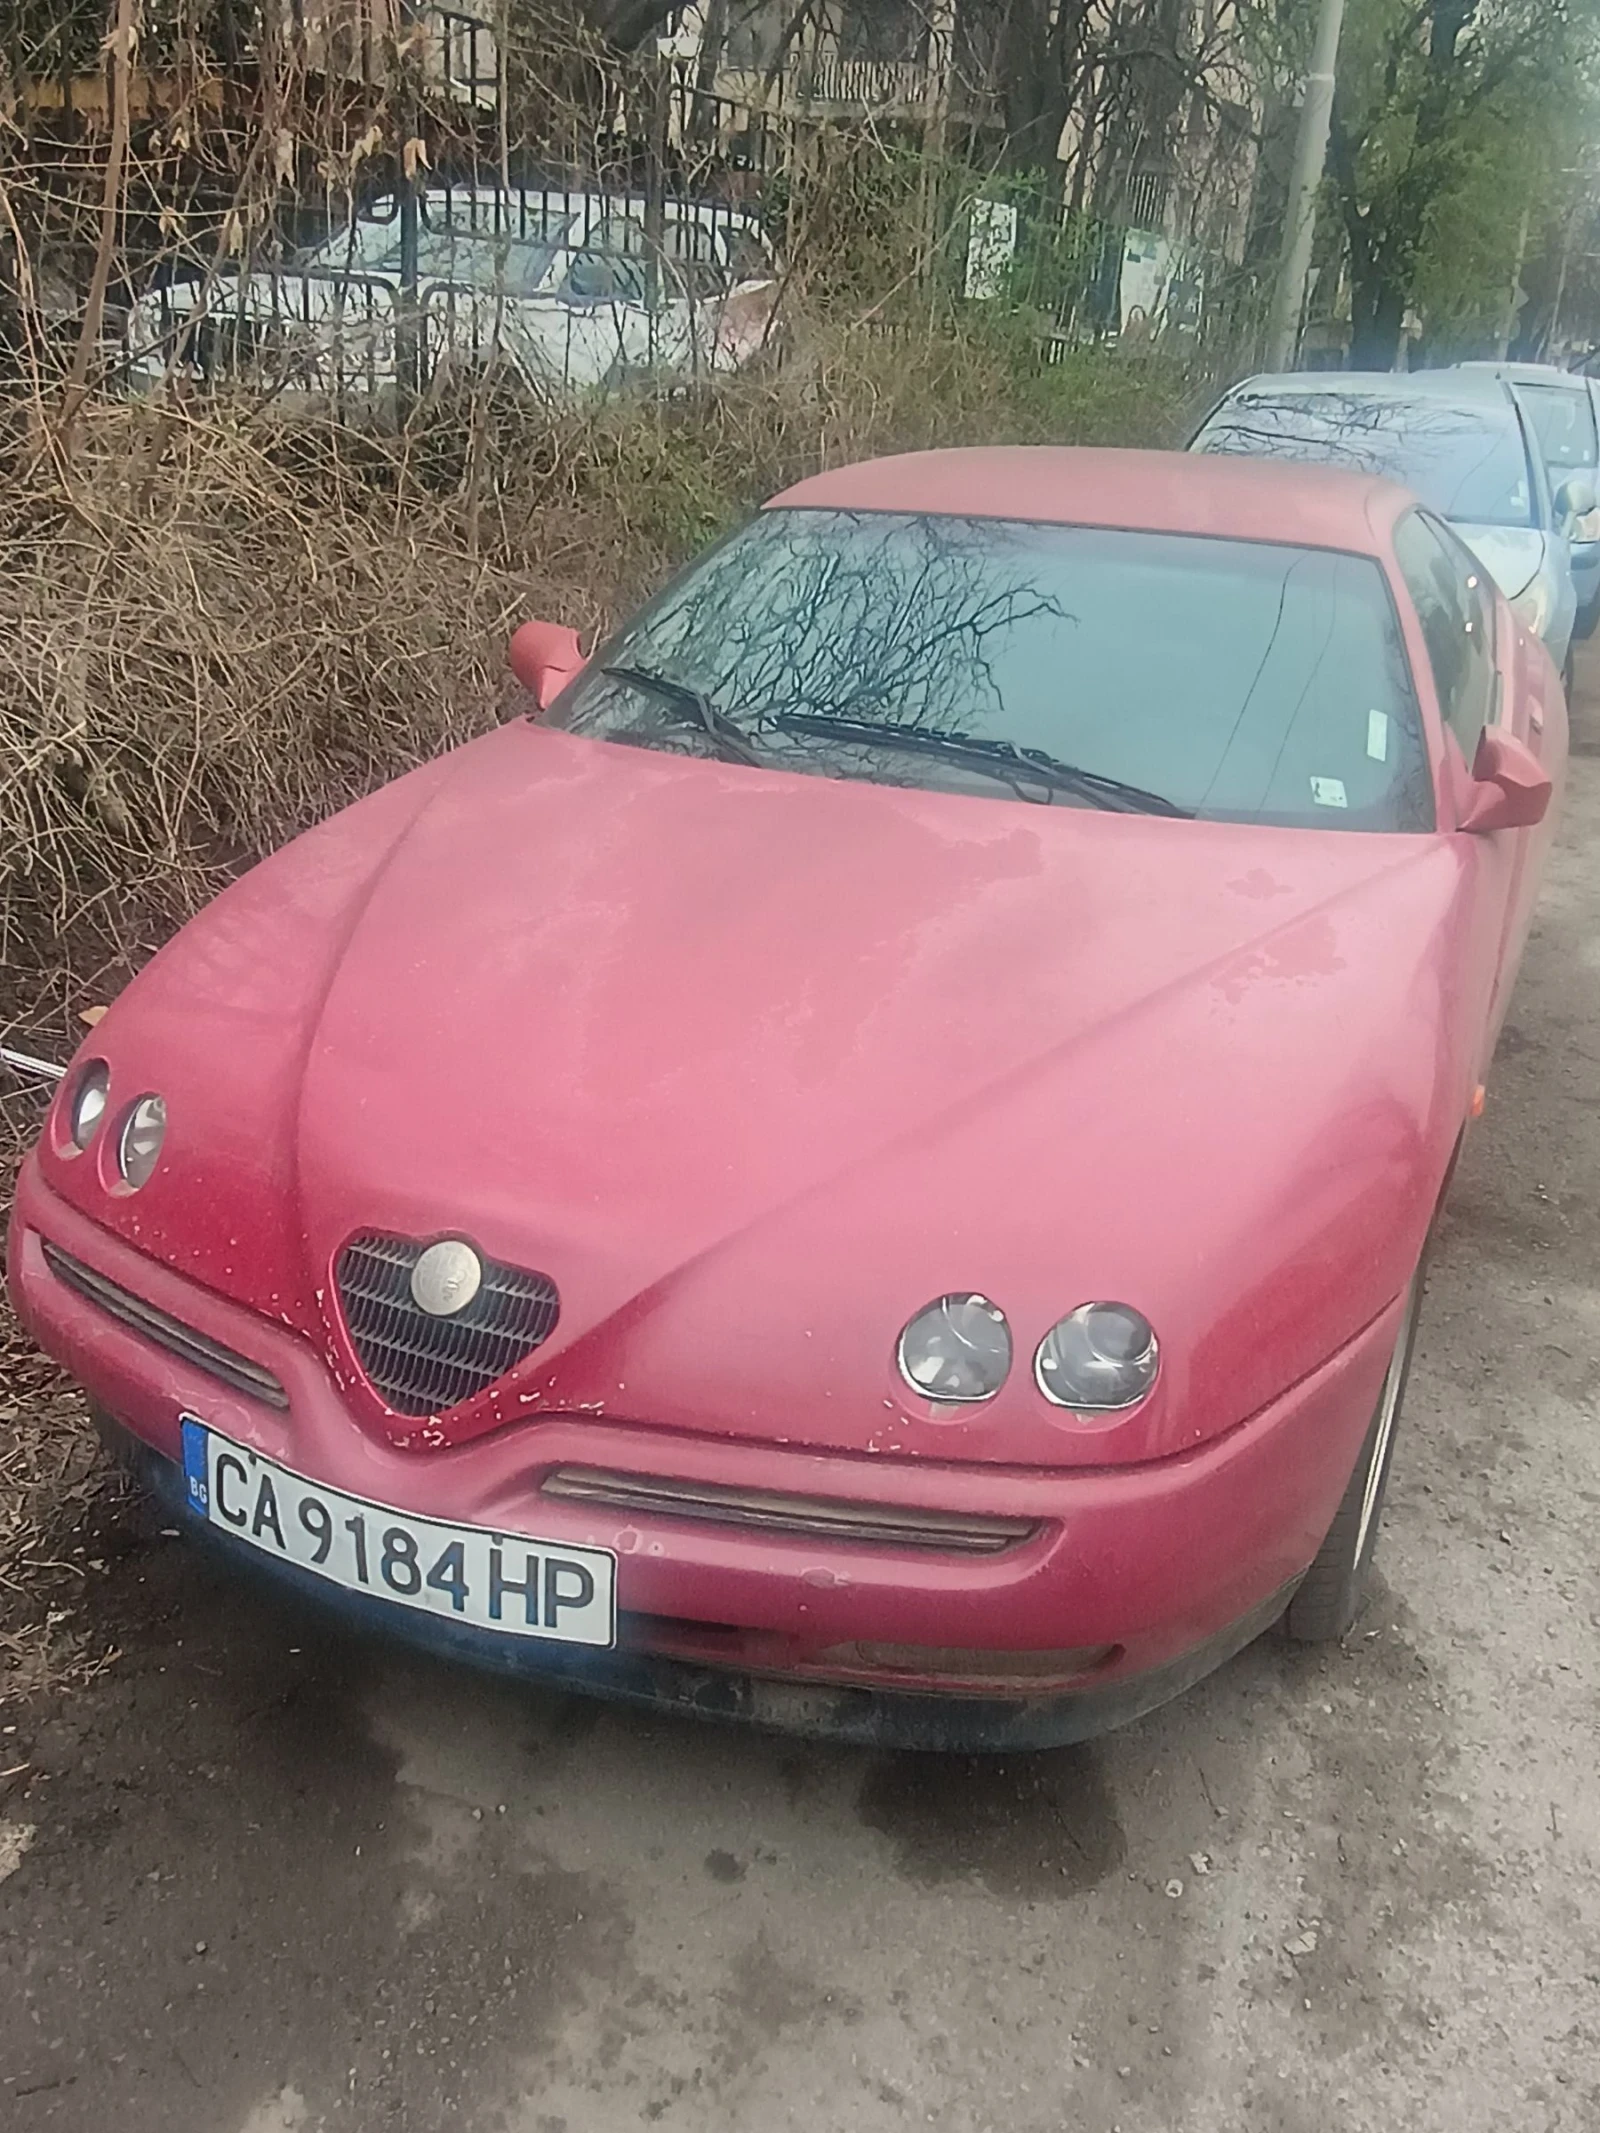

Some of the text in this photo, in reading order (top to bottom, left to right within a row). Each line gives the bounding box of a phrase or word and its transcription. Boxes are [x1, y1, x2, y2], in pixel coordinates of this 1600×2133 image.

[189, 1476, 208, 1505] BG
[215, 1453, 594, 1629] CA 9184 HP
